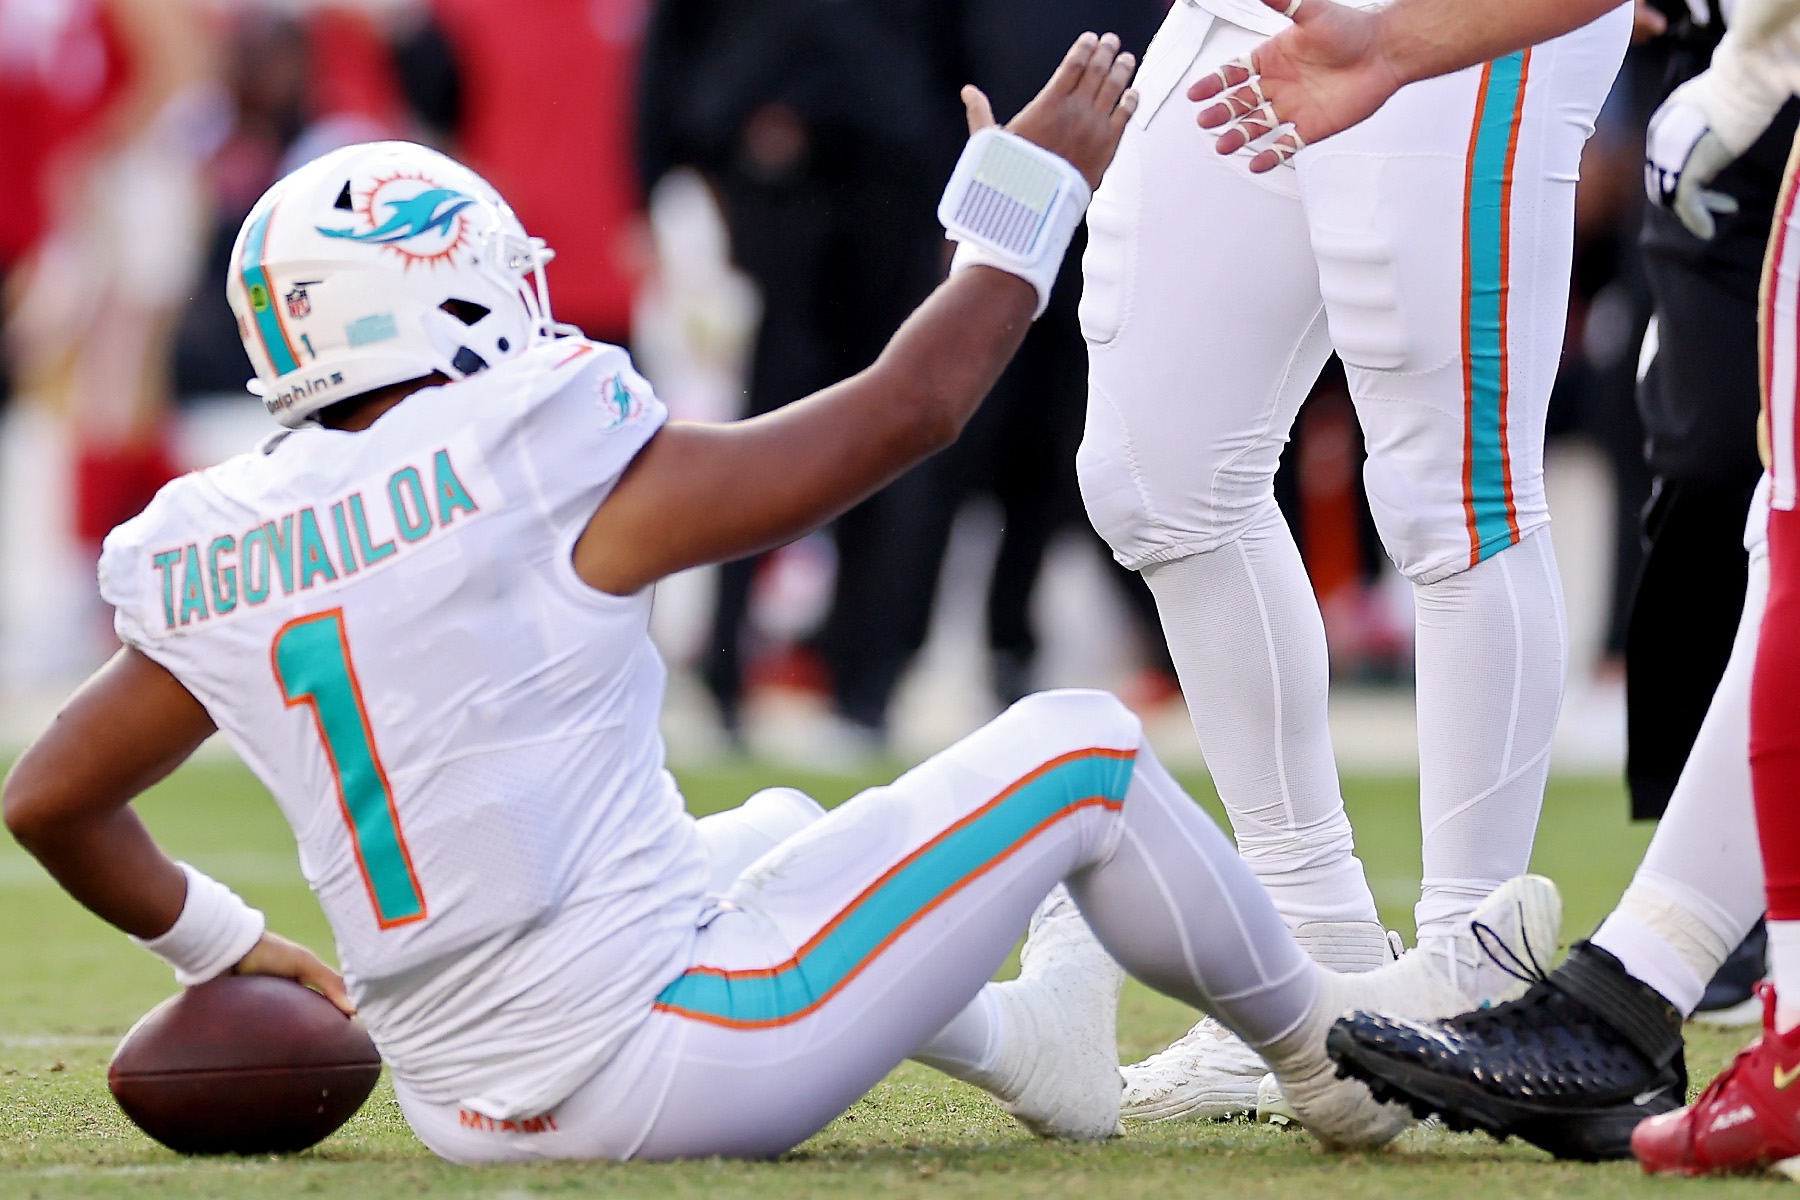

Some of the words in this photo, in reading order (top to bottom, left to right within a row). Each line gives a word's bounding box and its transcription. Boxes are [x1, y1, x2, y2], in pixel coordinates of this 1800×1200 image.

[153, 448, 479, 631] TAGOVAILOA
[270, 607, 427, 930] 1
[459, 1110, 559, 1134] MIAMI
